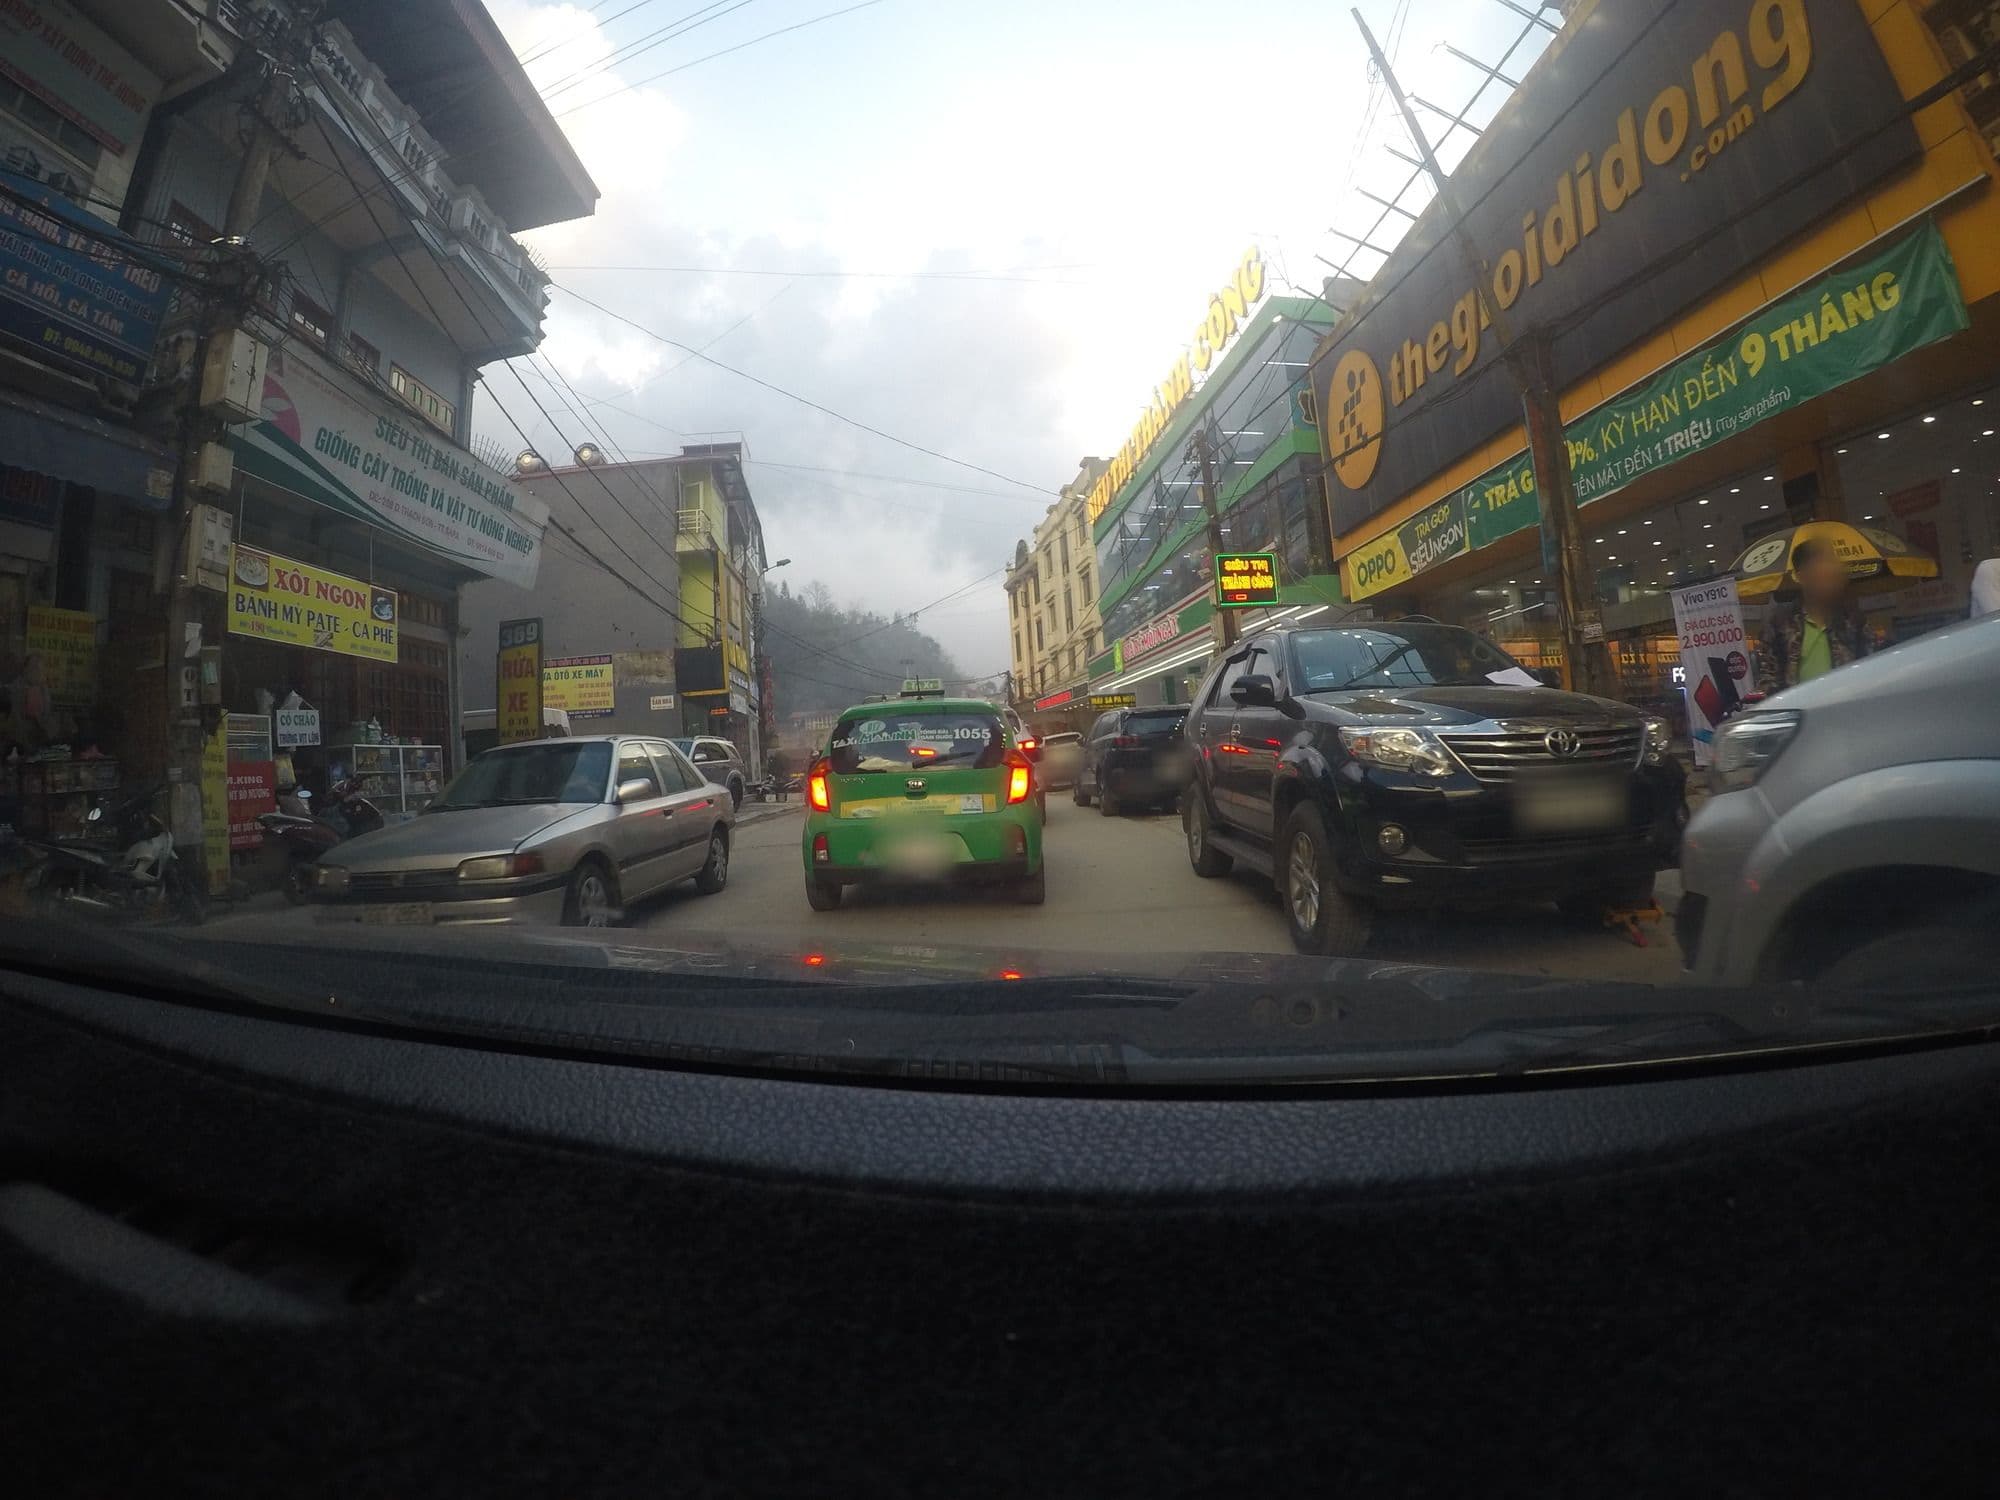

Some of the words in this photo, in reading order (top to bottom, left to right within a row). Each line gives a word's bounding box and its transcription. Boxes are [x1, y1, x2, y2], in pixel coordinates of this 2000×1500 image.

[1682, 103, 1754, 182] .com
[1132, 353, 1192, 462] THÀNH
[1191, 245, 1266, 373] CÔNG
[1601, 413, 1626, 454] KỲ
[1631, 387, 1681, 438] HẠN
[1684, 353, 1739, 411] ĐẾN
[1740, 333, 1766, 379] 9
[1769, 271, 1900, 362] THÁNG
[1597, 461, 1623, 487] MẶT
[1624, 444, 1653, 476] ĐẾN
[1654, 440, 1664, 461] 1
[1663, 418, 1714, 456] TRIỆU
[315, 426, 361, 470] GIỐNG
[361, 452, 389, 483] CÂY
[390, 464, 430, 505] TRỒNG
[446, 495, 467, 524] VẬT
[466, 506, 482, 529] TƯ
[479, 514, 506, 543] NÔNG
[504, 527, 535, 559] NGHIỆP
[1484, 471, 1520, 513] TRẢ
[1414, 515, 1431, 541] TRẢ
[1430, 504, 1451, 530] GÓP
[1221, 573, 1252, 590] THÀNH
[1250, 572, 1275, 590] CÔNG
[1224, 558, 1250, 571] SIÊU
[1249, 560, 1269, 573] THỊ
[1357, 548, 1396, 588] OPPO
[235, 591, 278, 620] BÁNH
[273, 567, 311, 597] XÔI
[315, 578, 368, 611] NGON
[1681, 591, 1704, 607] Vivo
[1703, 585, 1729, 603] Y91C
[1682, 626, 1743, 650] 2.990.000
[502, 650, 536, 681] RỬA
[506, 691, 530, 713] XE
[280, 713, 291, 727] CÓ
[831, 736, 859, 750] TAXI
[953, 727, 992, 741] 1055
